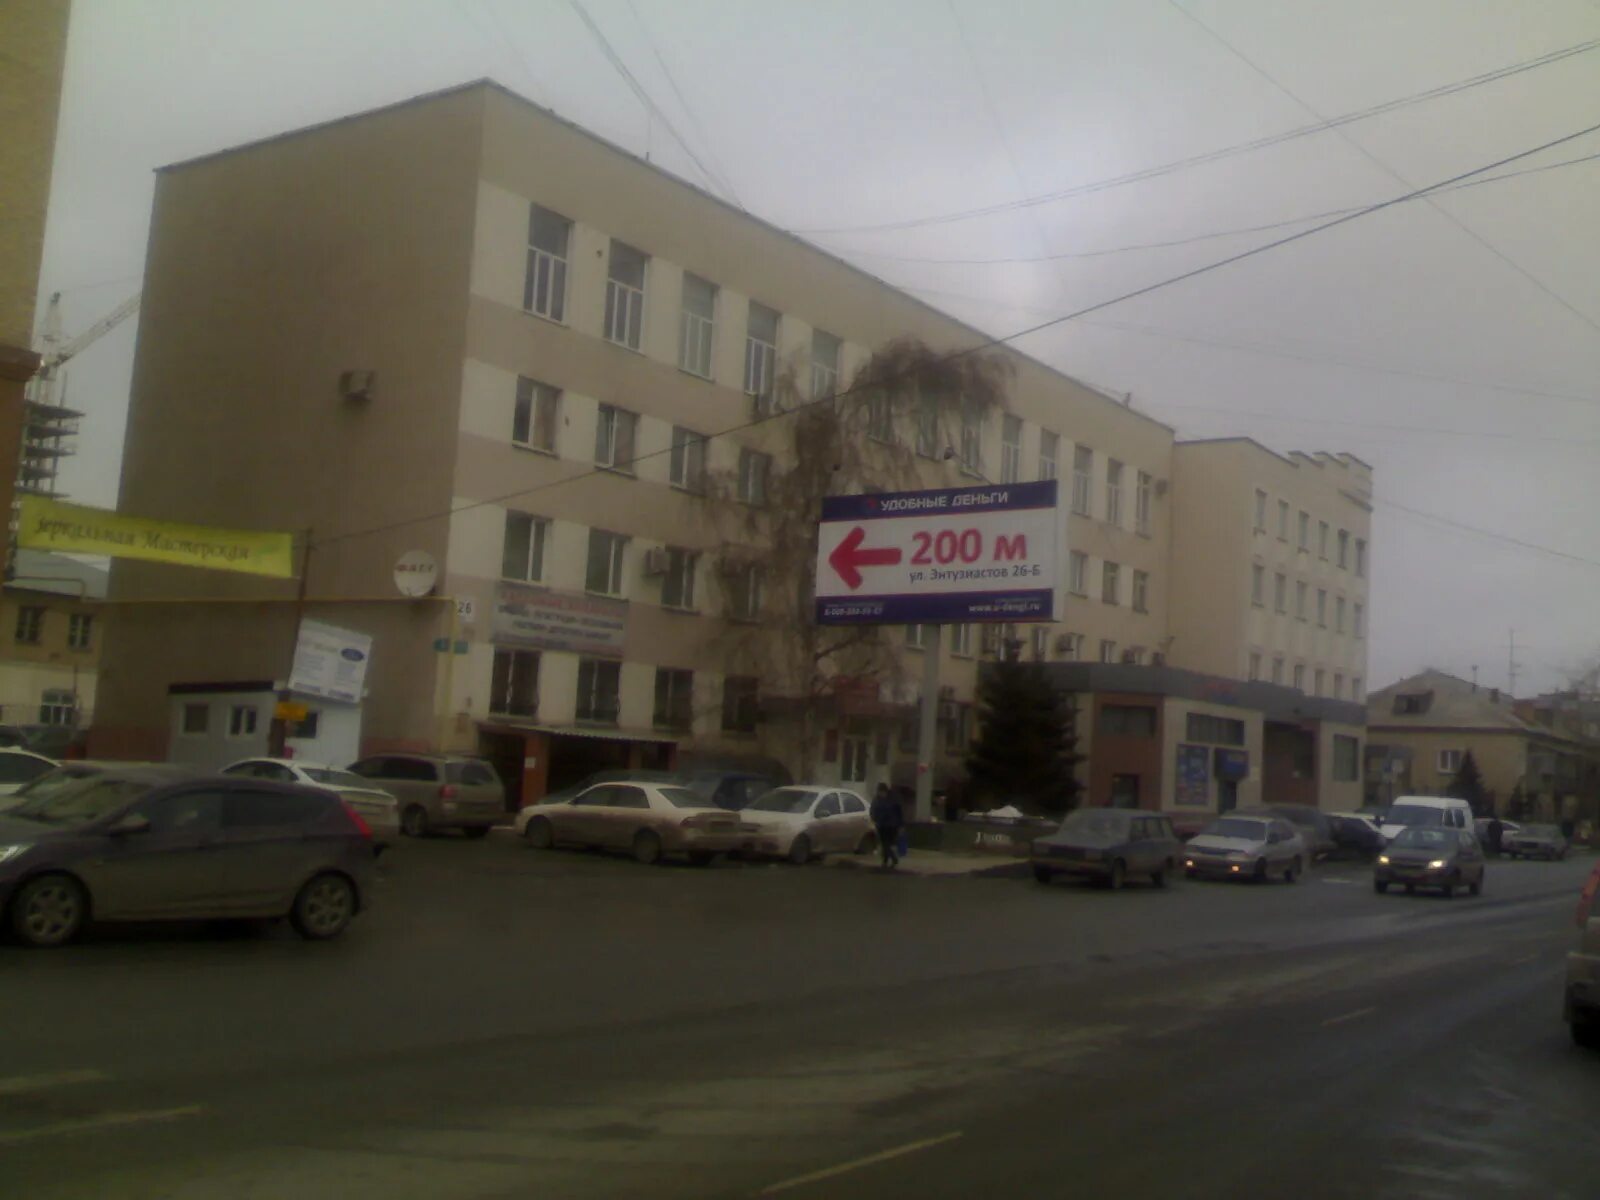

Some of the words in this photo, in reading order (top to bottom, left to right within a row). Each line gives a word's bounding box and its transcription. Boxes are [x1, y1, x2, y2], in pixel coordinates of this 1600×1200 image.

[880, 496, 948, 511] УДОБНЫЕ
[951, 491, 1009, 507] ДЕНЬГИ
[910, 528, 983, 565] 200
[930, 568, 1008, 583] Энтузиастов
